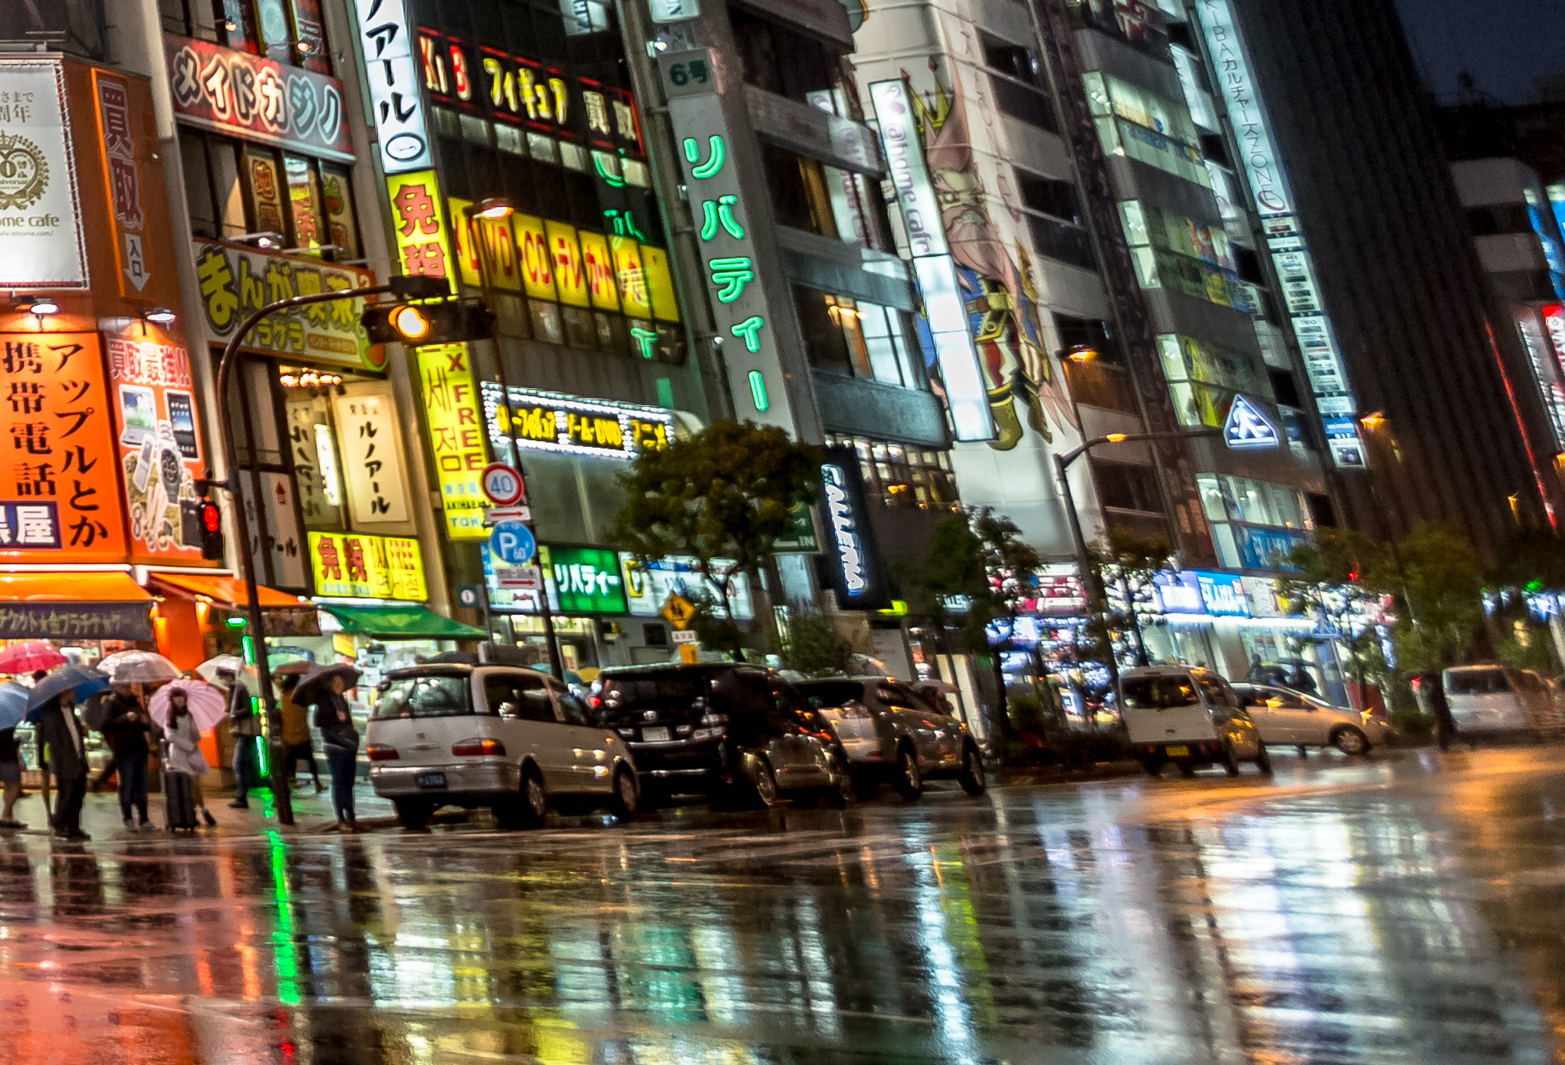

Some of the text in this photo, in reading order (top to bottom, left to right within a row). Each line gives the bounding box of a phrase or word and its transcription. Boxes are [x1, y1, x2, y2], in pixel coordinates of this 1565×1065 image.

[28, 213, 59, 227] cafe
[127, 236, 145, 277] 入口
[682, 134, 768, 412] リバティー
[2, 339, 56, 495] 携帯電話
[51, 343, 108, 547] アップルとか
[491, 476, 513, 494] 40
[499, 532, 517, 559] P
